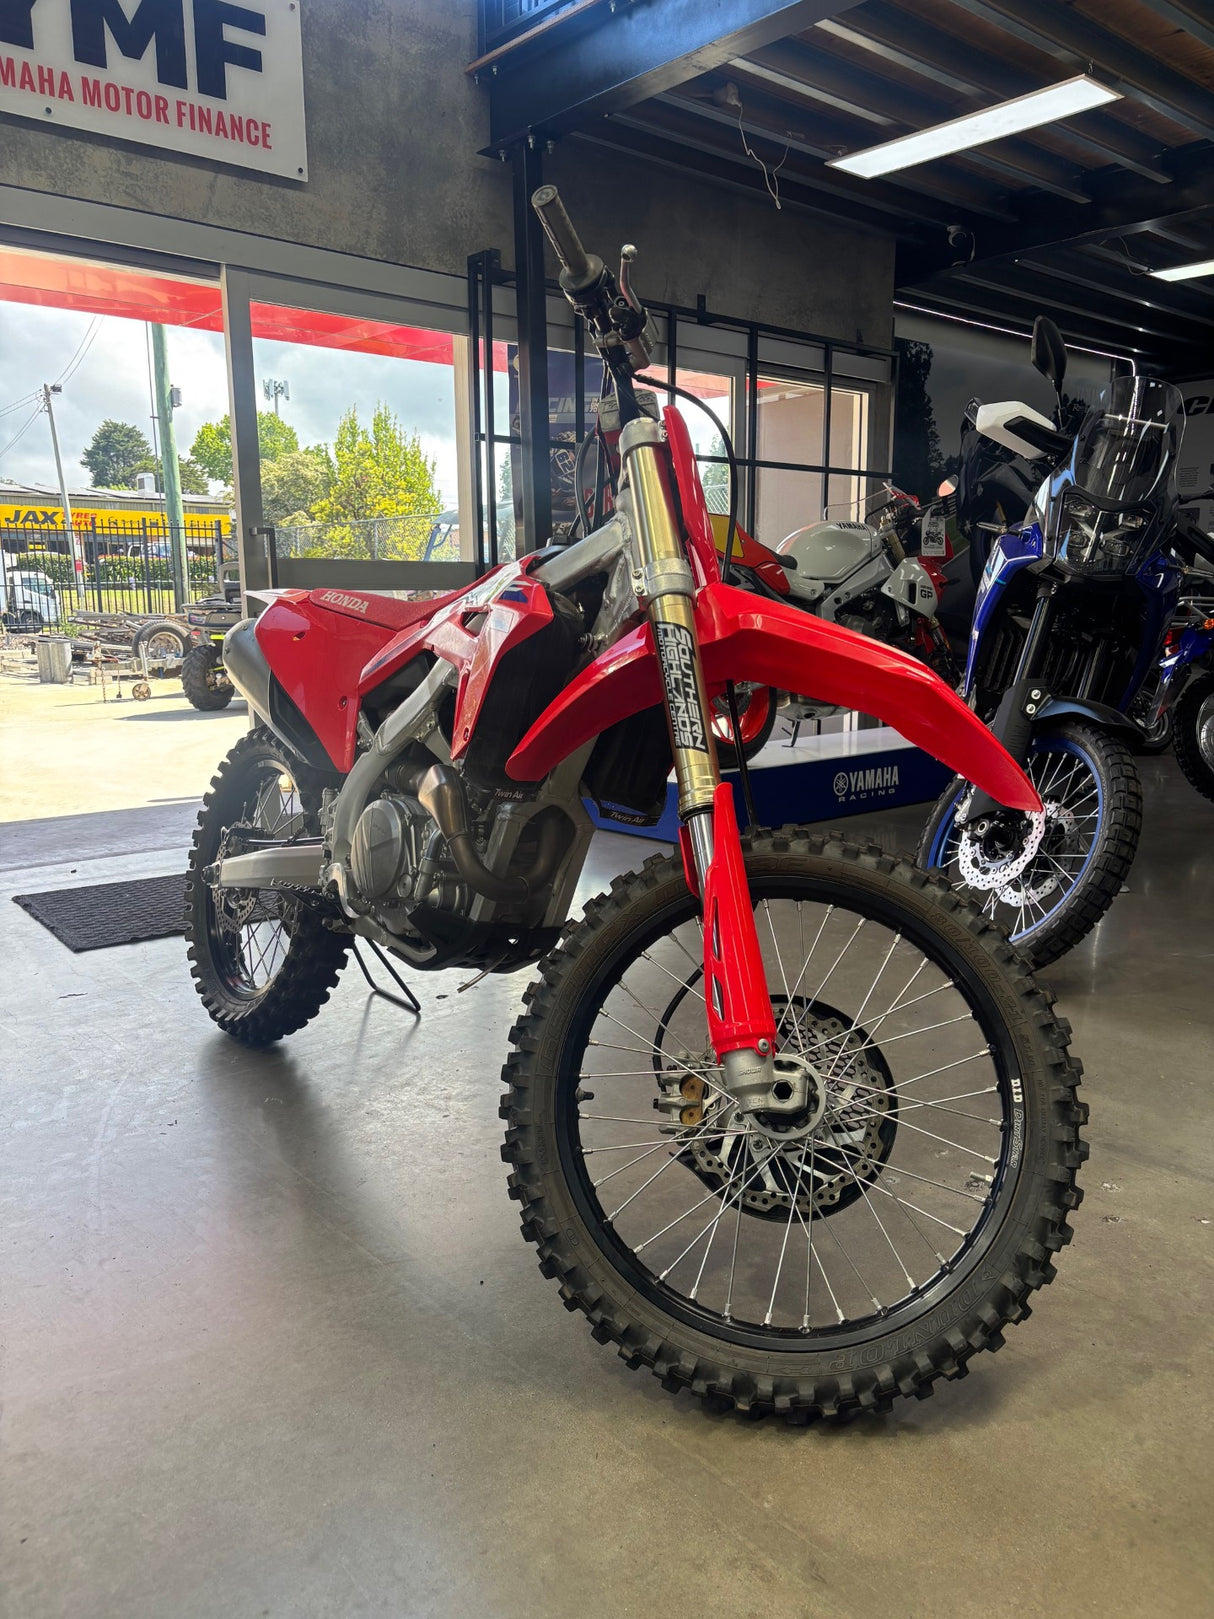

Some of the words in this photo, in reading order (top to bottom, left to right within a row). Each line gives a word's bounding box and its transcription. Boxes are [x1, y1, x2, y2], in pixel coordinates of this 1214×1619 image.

[81, 75, 170, 125] MOTOR
[175, 99, 273, 150] FINANCE
[4, 509, 60, 525] JAX
[836, 521, 867, 531] YAMAHA
[319, 590, 369, 614] HONDA
[920, 588, 933, 600] GP
[657, 623, 694, 747] HIGHLANDS
[674, 627, 706, 750] SOUTHERN
[669, 702, 681, 747] CENTRE
[849, 766, 899, 793] YAMAHA
[494, 788, 513, 798] Twin
[838, 788, 896, 803] RACING
[610, 811, 630, 822] Twin
[828, 1283, 982, 1370] DUNLOP
